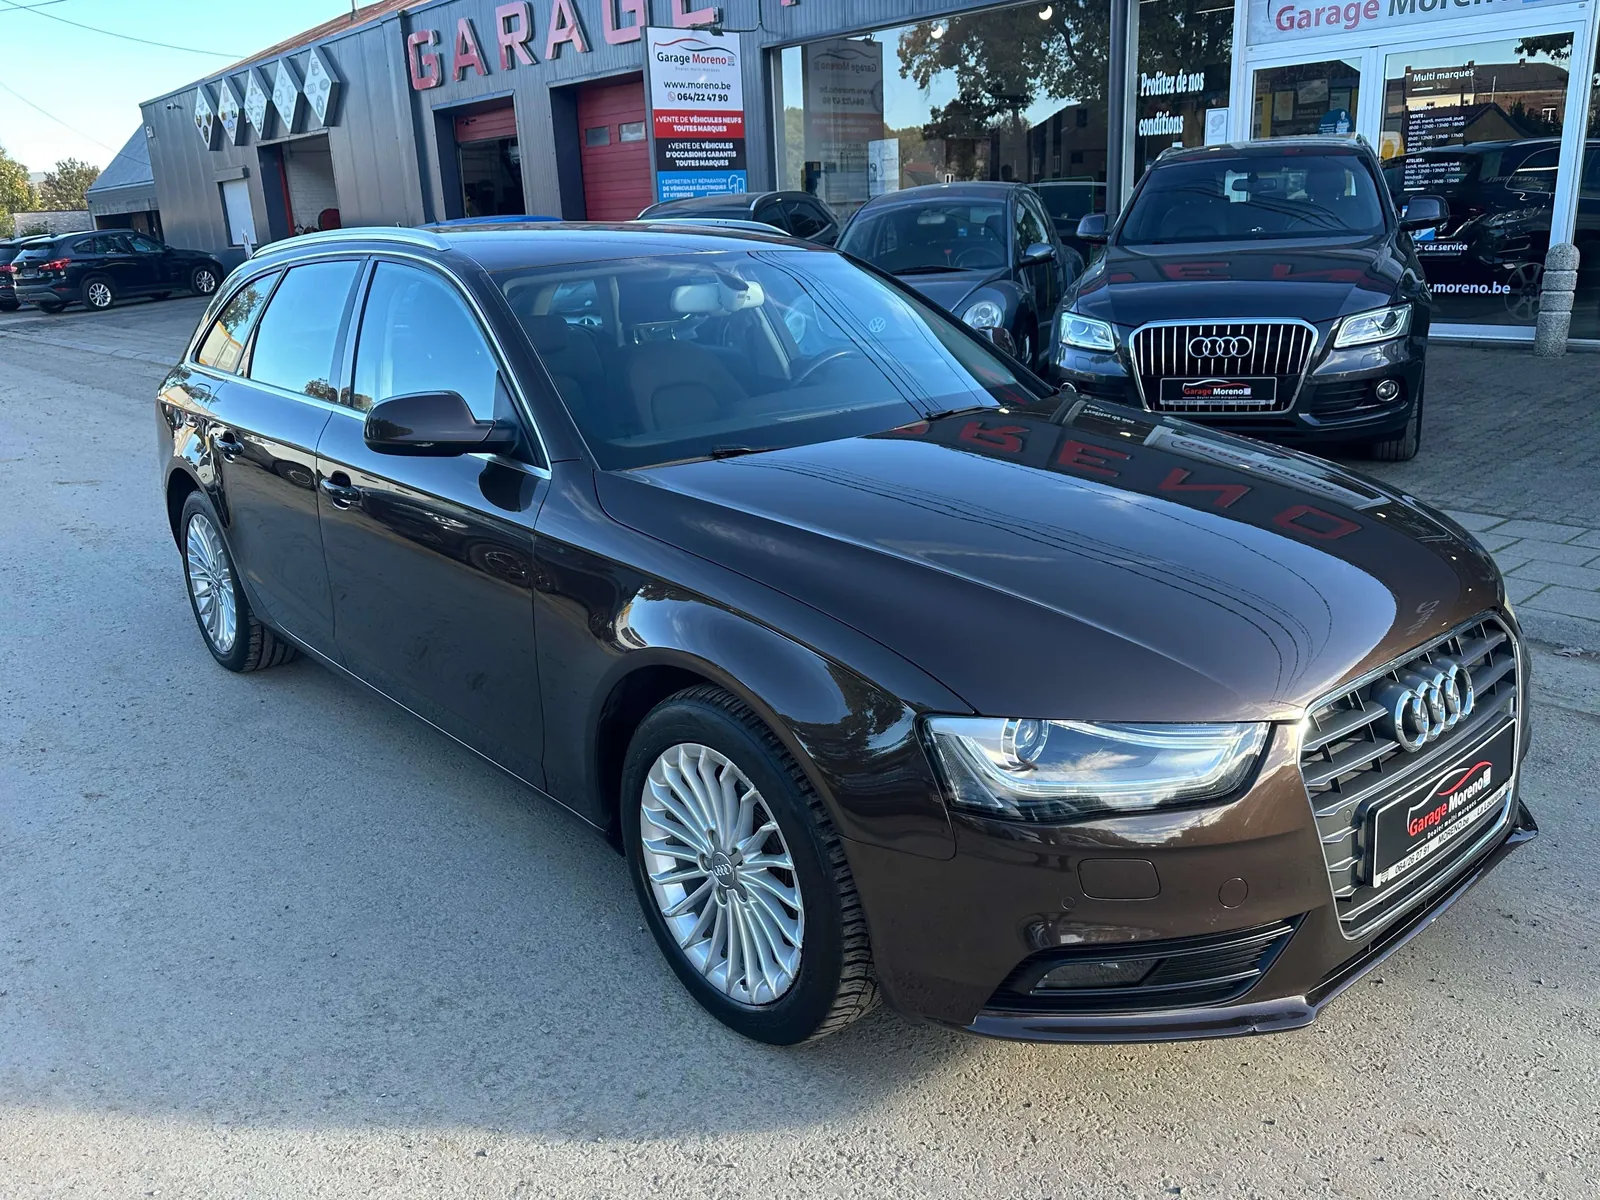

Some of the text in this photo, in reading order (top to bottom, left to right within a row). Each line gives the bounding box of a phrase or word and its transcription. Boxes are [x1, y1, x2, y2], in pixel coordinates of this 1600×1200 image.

[1276, 0, 1380, 31] Garage
[657, 52, 727, 66] Garage Moreno
[1413, 68, 1474, 82] Multi marques
[664, 82, 731, 90] www.moreno.be
[1140, 68, 1204, 96] Profitez de nos
[677, 92, 706, 102] 064/22
[706, 94, 716, 102] 47
[689, 115, 722, 124] VÉHICULES
[1139, 111, 1184, 136] conditions
[701, 141, 734, 149] VÉHICULES
[1438, 242, 1468, 251] service
[1428, 281, 1511, 294] .moreno.be
[1212, 388, 1244, 396] Moreno
[1409, 776, 1484, 836] Garage Moreno
[1426, 824, 1444, 840] Dealer
[1458, 800, 1477, 817] marques
